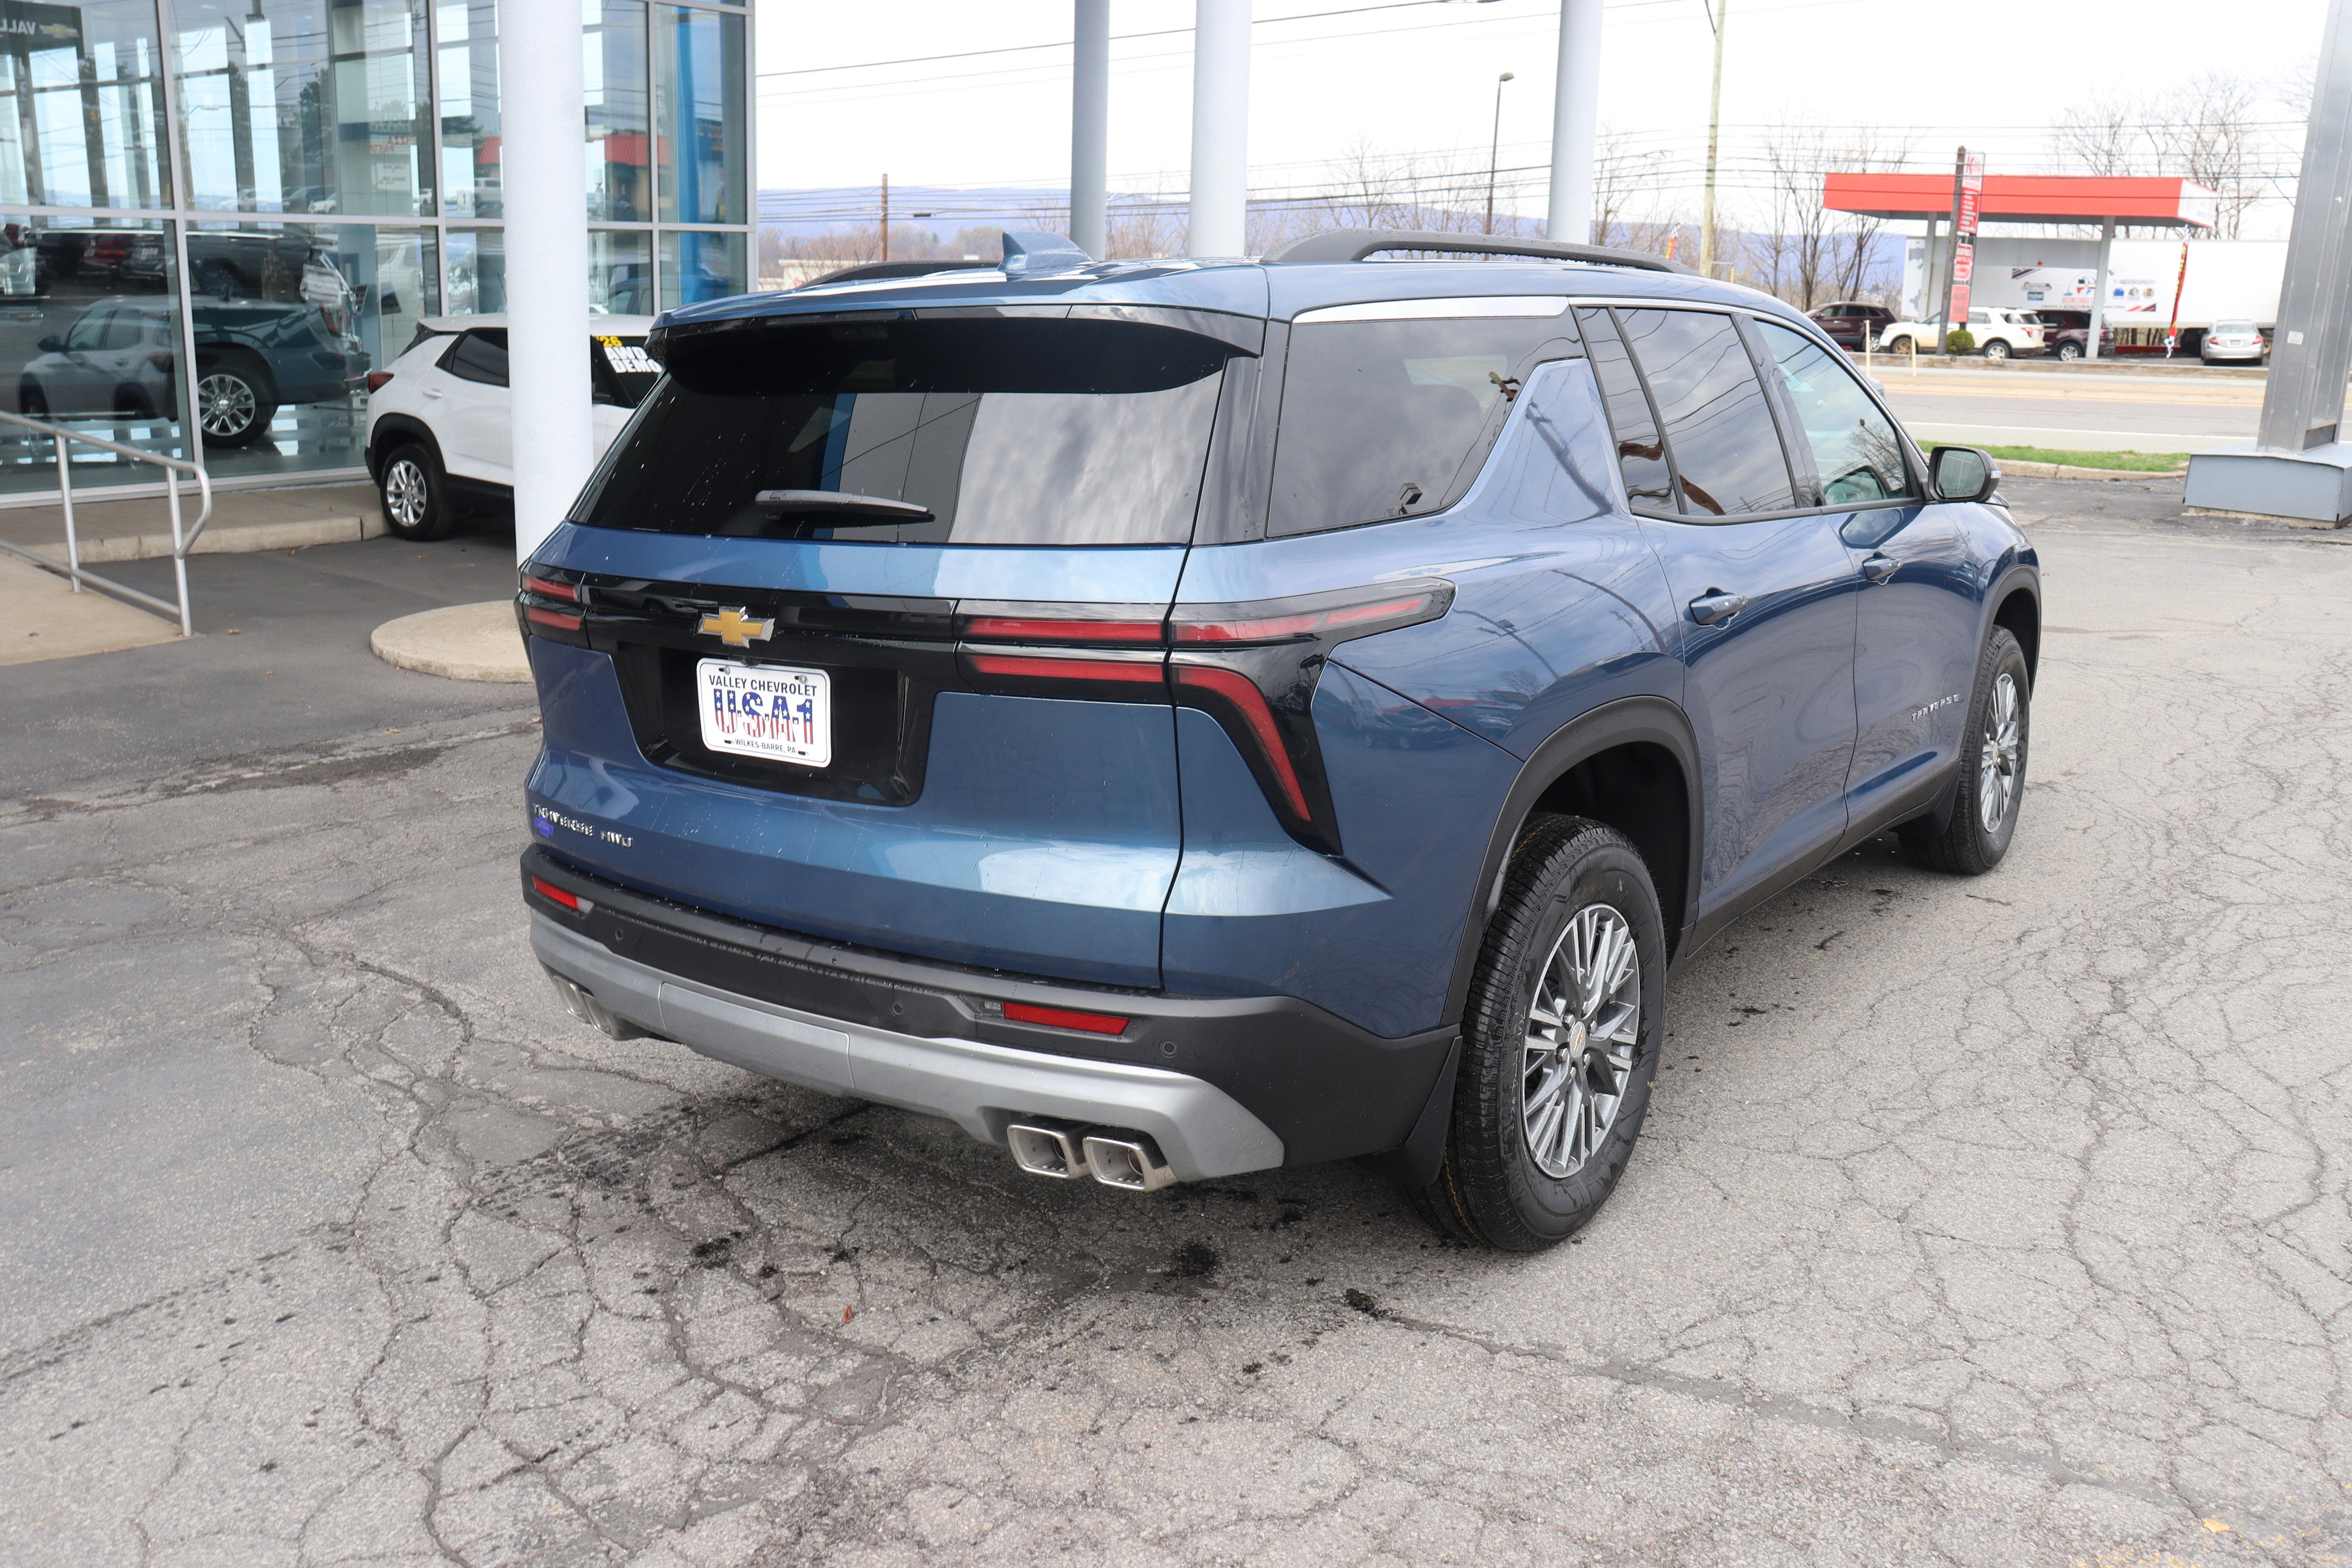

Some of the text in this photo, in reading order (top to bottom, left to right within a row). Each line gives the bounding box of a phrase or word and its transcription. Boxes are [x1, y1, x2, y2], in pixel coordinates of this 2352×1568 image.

[604, 346, 648, 360] AWD
[610, 359, 663, 373] DEMO
[709, 674, 817, 697] VALLEY CHEVROLET
[1912, 694, 1960, 721] TRAVERSE
[735, 738, 786, 753] WILKES-BARRE,
